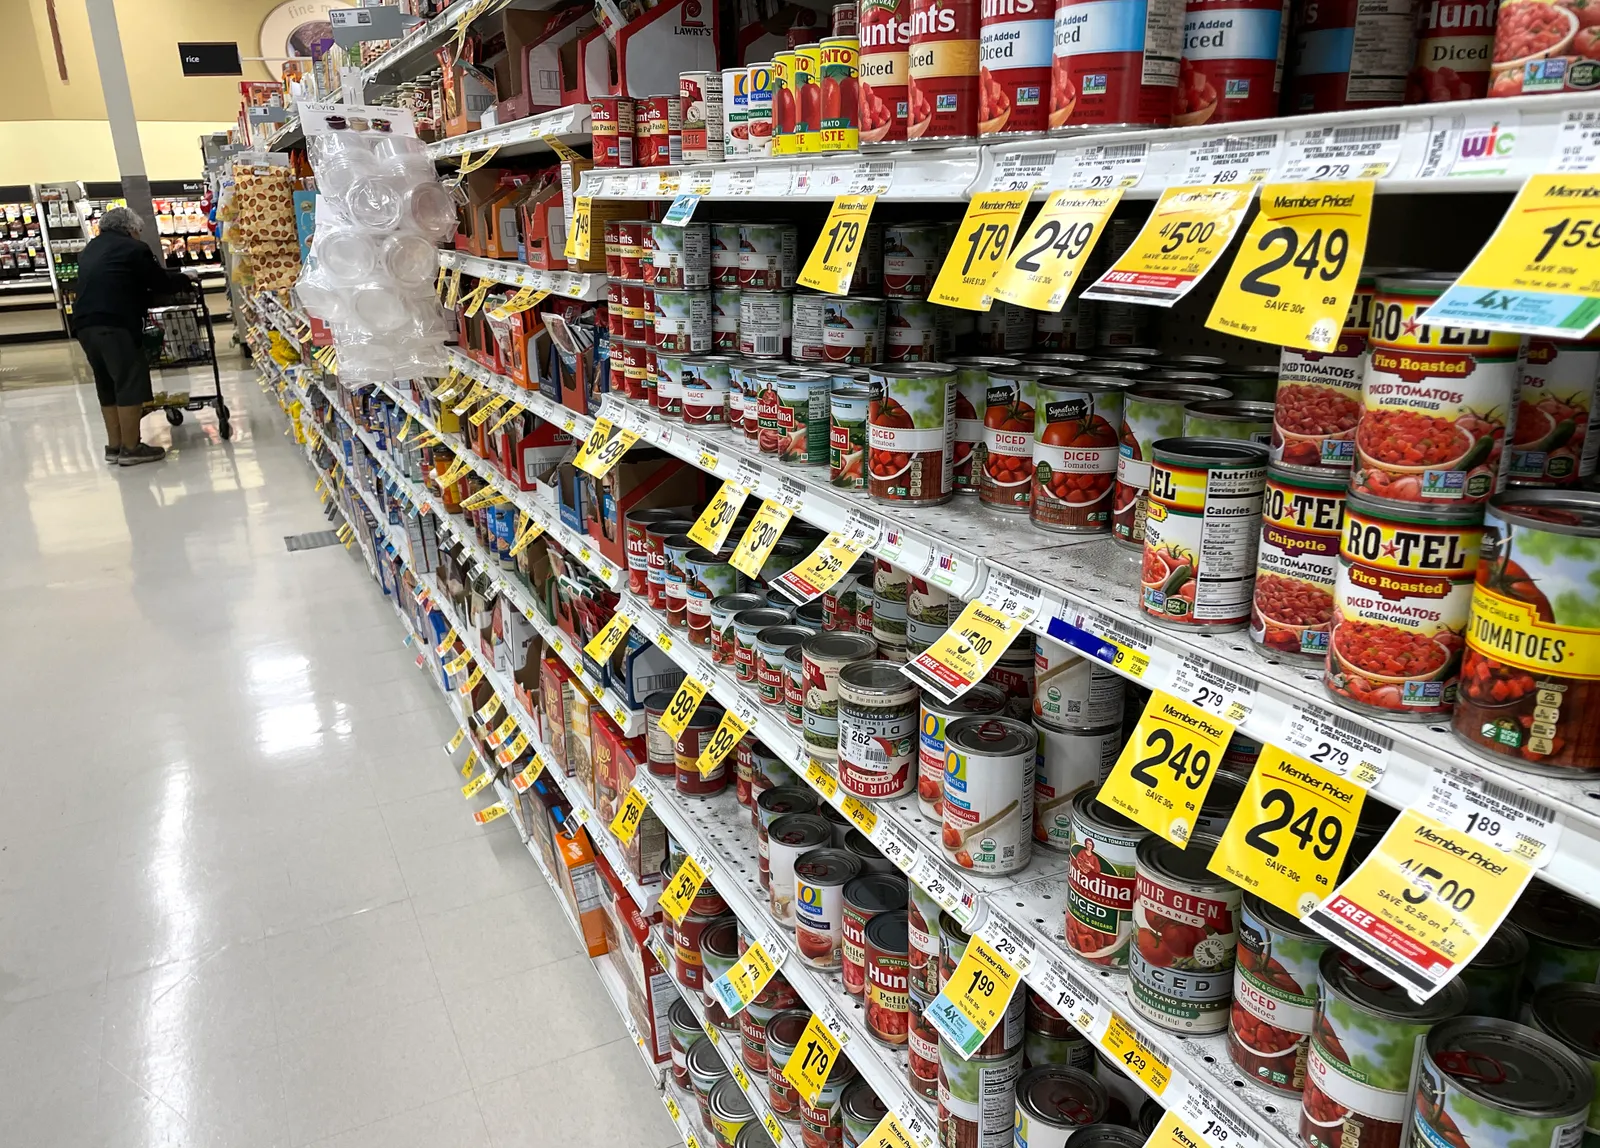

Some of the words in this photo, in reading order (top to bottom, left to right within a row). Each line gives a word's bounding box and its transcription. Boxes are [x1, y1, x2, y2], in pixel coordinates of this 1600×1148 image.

[909, 3, 955, 36] unts
[1063, 14, 1087, 26] Added
[1198, 20, 1232, 29] Added
[674, 26, 713, 36] LAWRY'S
[860, 14, 909, 47] unts
[994, 31, 1020, 41] Added
[1183, 31, 1224, 49] iced
[186, 55, 199, 63] rice
[821, 49, 851, 64] ENTO
[981, 42, 1013, 61] Diced
[1432, 44, 1488, 61] Diced
[861, 61, 893, 77] Diced
[821, 130, 844, 142] ASTE
[979, 201, 1005, 210] Member
[1274, 195, 1319, 208] Member
[1321, 194, 1354, 208] Price!
[1106, 272, 1136, 282] FREE
[1264, 299, 1289, 312] SAVE
[1322, 294, 1337, 306] ea
[1299, 363, 1355, 379] TOMATOES
[1374, 353, 1396, 369] Fire
[1399, 358, 1466, 374] Roasted
[687, 392, 704, 400] SAUCE
[1369, 384, 1393, 396] DICED
[1394, 385, 1464, 404] TOMATOES
[871, 429, 895, 440] DICED
[995, 434, 1026, 445] DICED
[995, 443, 1026, 452] Tomatoes
[1063, 460, 1100, 470] Tomatoes
[1064, 452, 1100, 462] DICED
[1207, 507, 1250, 515] Calories
[1268, 531, 1327, 552] Chipotle
[1261, 552, 1279, 564] DICED
[1280, 556, 1333, 576] TOMATOES
[1352, 568, 1376, 586] Fire
[1380, 576, 1443, 594] Roasted
[1347, 597, 1373, 609] DICED
[1375, 601, 1441, 622] TOMATOES
[1365, 611, 1388, 622] GREEN
[1390, 616, 1420, 627] CHILIES
[1474, 622, 1567, 663] TOMATOES
[919, 655, 939, 670] FREE
[1163, 703, 1199, 727] Member
[1199, 720, 1223, 739] Price!
[852, 731, 870, 745] 262
[1301, 714, 1319, 727] ROTEL
[1320, 723, 1334, 733] FIRE
[1334, 728, 1362, 746] ROASTED
[1362, 742, 1382, 754] DICED
[870, 778, 899, 794] MUIR
[1278, 760, 1322, 787] Member
[1322, 782, 1353, 804] Price!
[1145, 789, 1166, 804] SAVE
[1162, 798, 1174, 810] 30¢
[1185, 801, 1195, 811] ea
[1462, 787, 1500, 808] TOMATOES
[1526, 816, 1545, 828] WITH
[1465, 795, 1488, 810] GREEN
[1490, 806, 1516, 822] CHILES
[1415, 825, 1469, 857] Member
[1468, 851, 1508, 876] Price!
[1265, 858, 1287, 875] SAVE
[1287, 869, 1301, 882] 30¢
[1069, 862, 1130, 901] ontadina
[1315, 873, 1328, 885] ea
[1069, 890, 1107, 918] DICED
[1136, 879, 1165, 903] MUIR
[1174, 894, 1218, 919] GLEN
[1143, 900, 1199, 925] ORGANIC
[1332, 899, 1375, 929] FREE
[1377, 889, 1403, 908] SAVE
[1428, 919, 1441, 929] on
[1441, 926, 1449, 934] 4
[976, 946, 997, 970] Member
[1130, 953, 1211, 992] DICED
[1240, 980, 1277, 1012] DICED
[1168, 1007, 1190, 1017] HERBS
[1338, 1061, 1366, 1081] PEPPERS
[984, 1086, 1006, 1094] Calories
